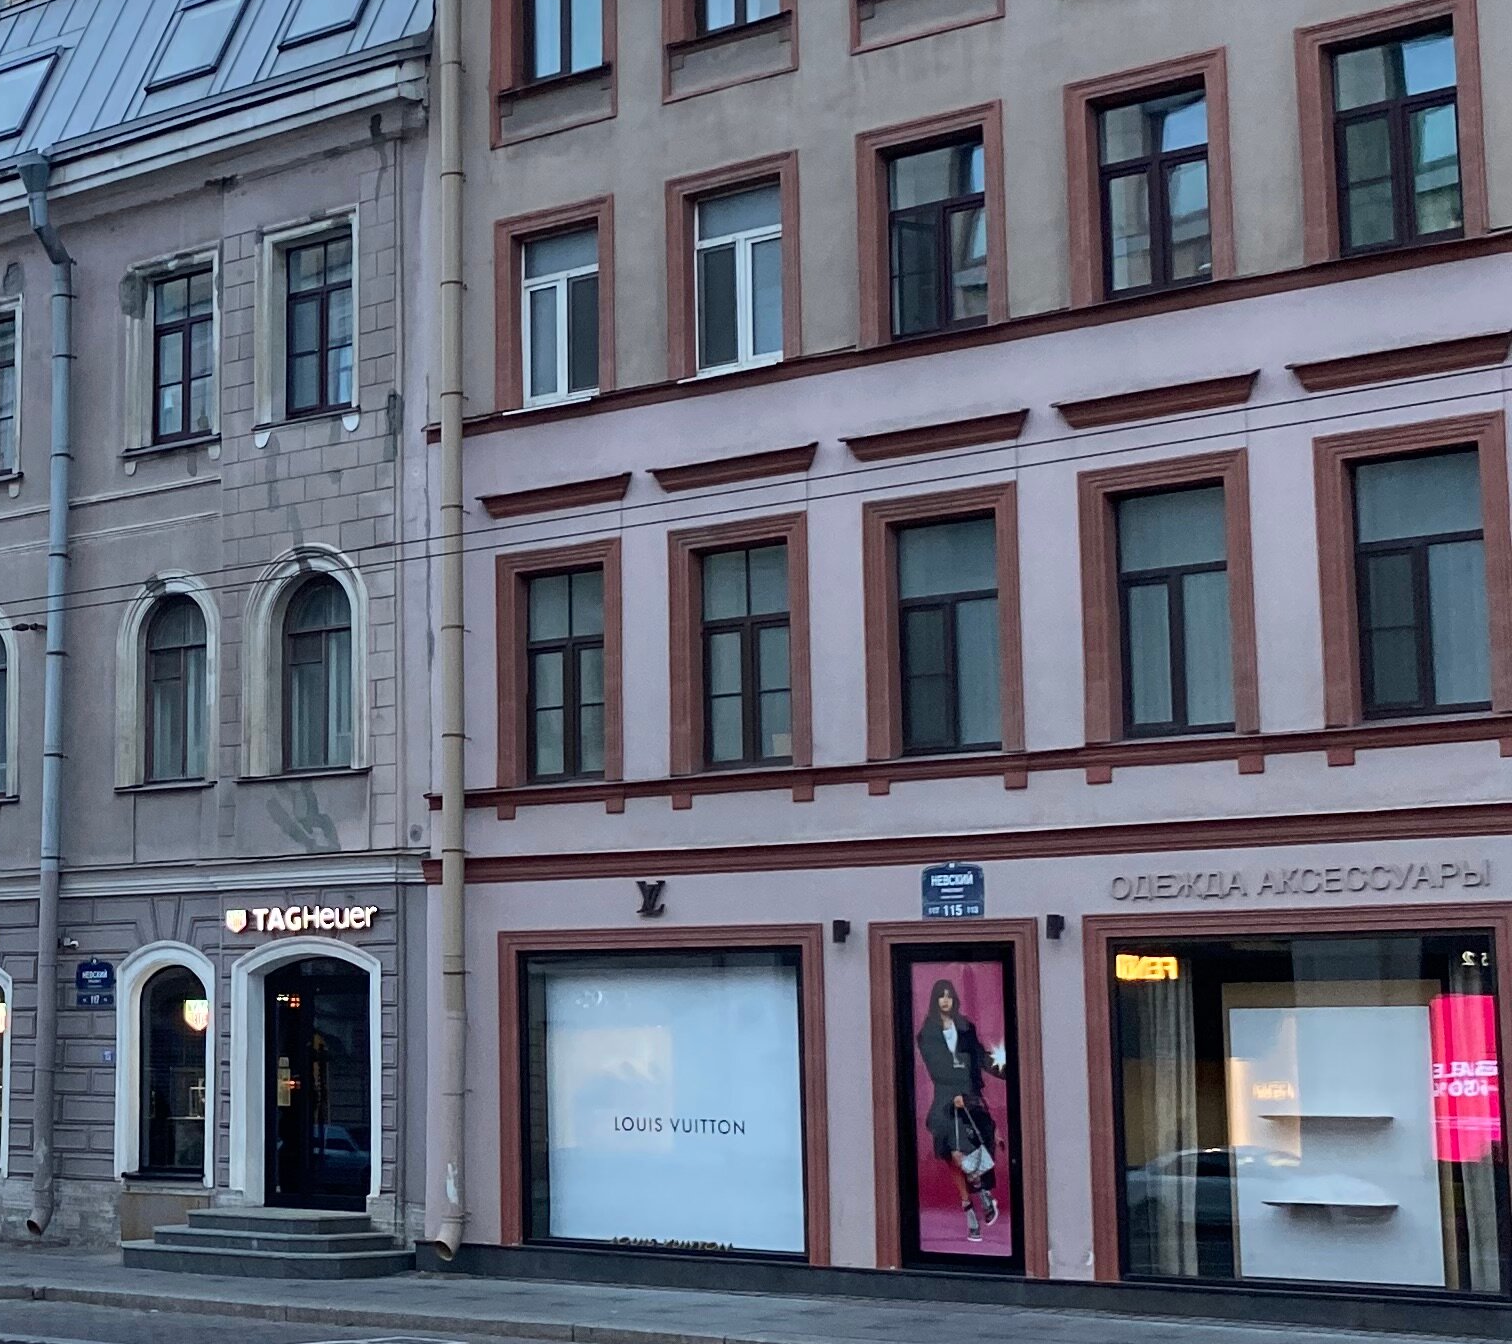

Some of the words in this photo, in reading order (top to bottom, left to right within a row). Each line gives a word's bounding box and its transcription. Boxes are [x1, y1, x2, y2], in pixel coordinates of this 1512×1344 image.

[931, 871, 973, 886] НЕВСКИЙ
[1110, 871, 1248, 901] ОДЕЖДА
[1257, 859, 1490, 896] АКСЕССУАРЫ
[943, 904, 963, 916] 115
[614, 1116, 662, 1132] LOUIS
[669, 1118, 745, 1135] VUITTON
